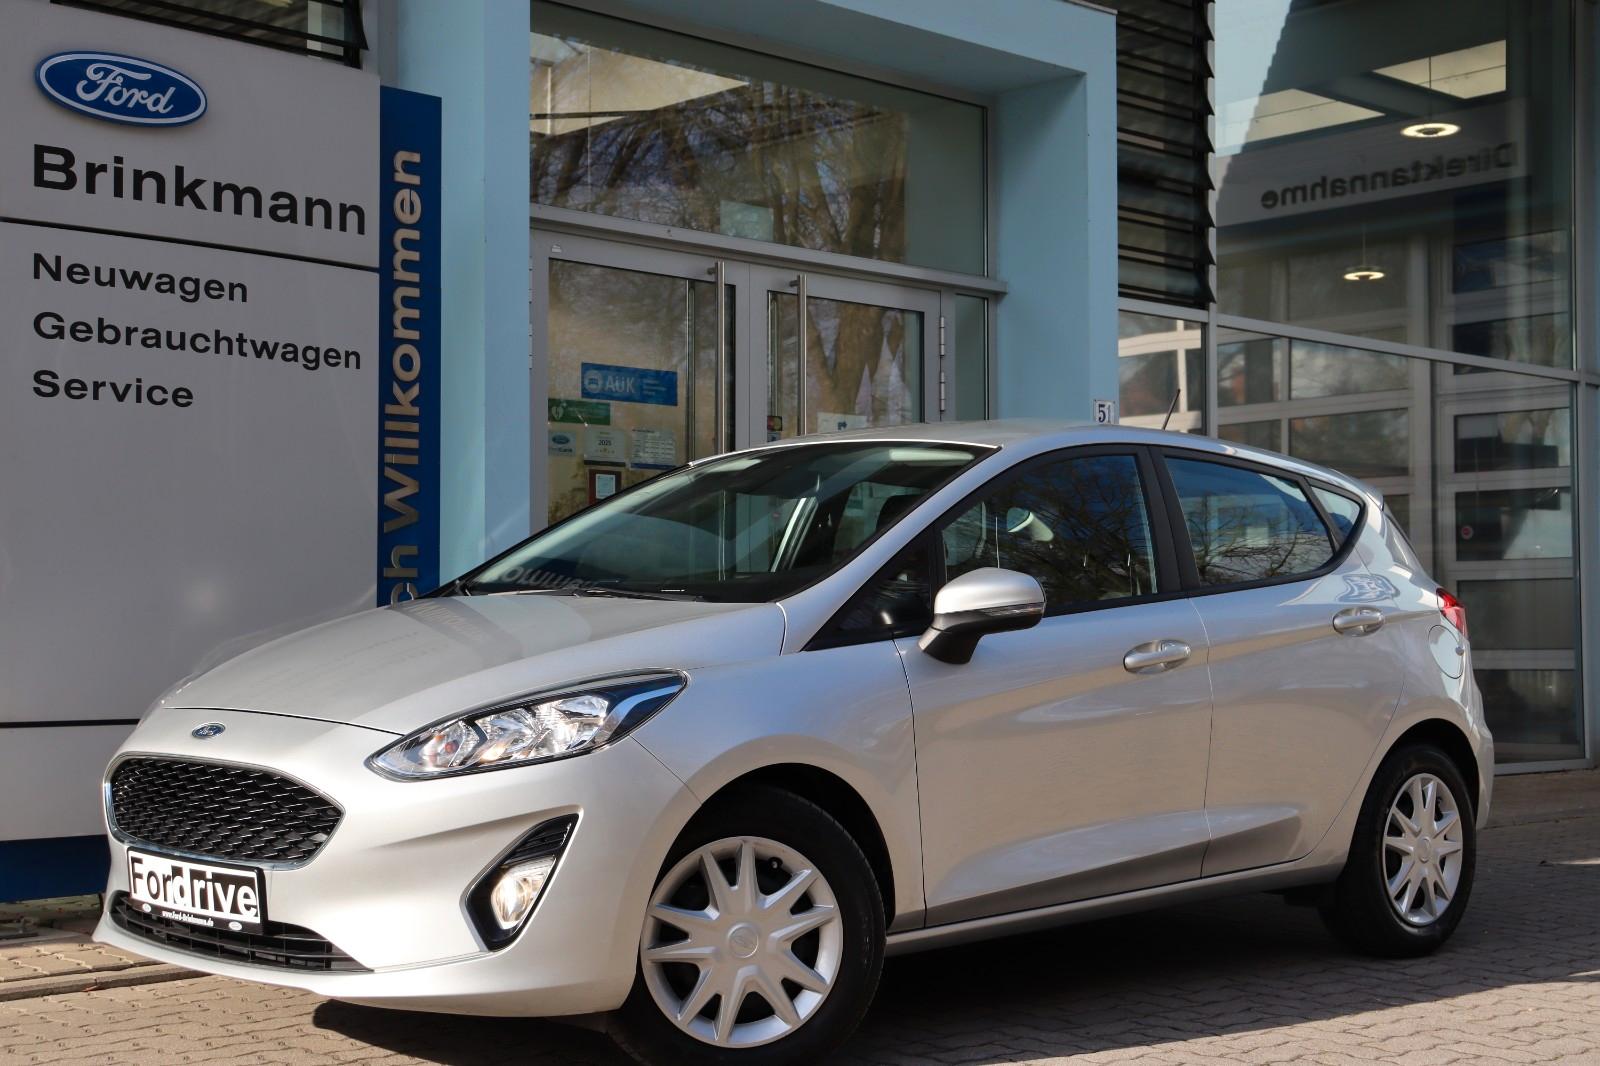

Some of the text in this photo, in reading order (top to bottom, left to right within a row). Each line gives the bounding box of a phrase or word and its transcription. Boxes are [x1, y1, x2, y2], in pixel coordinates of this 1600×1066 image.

[75, 62, 175, 114] Ford
[33, 143, 367, 236] Brinkmann
[32, 252, 249, 303] Neuwagen
[32, 311, 362, 371] Gebrauchtwagen
[383, 150, 422, 534] Willkommen
[32, 369, 194, 409] Service
[130, 856, 259, 918] Fordrive
